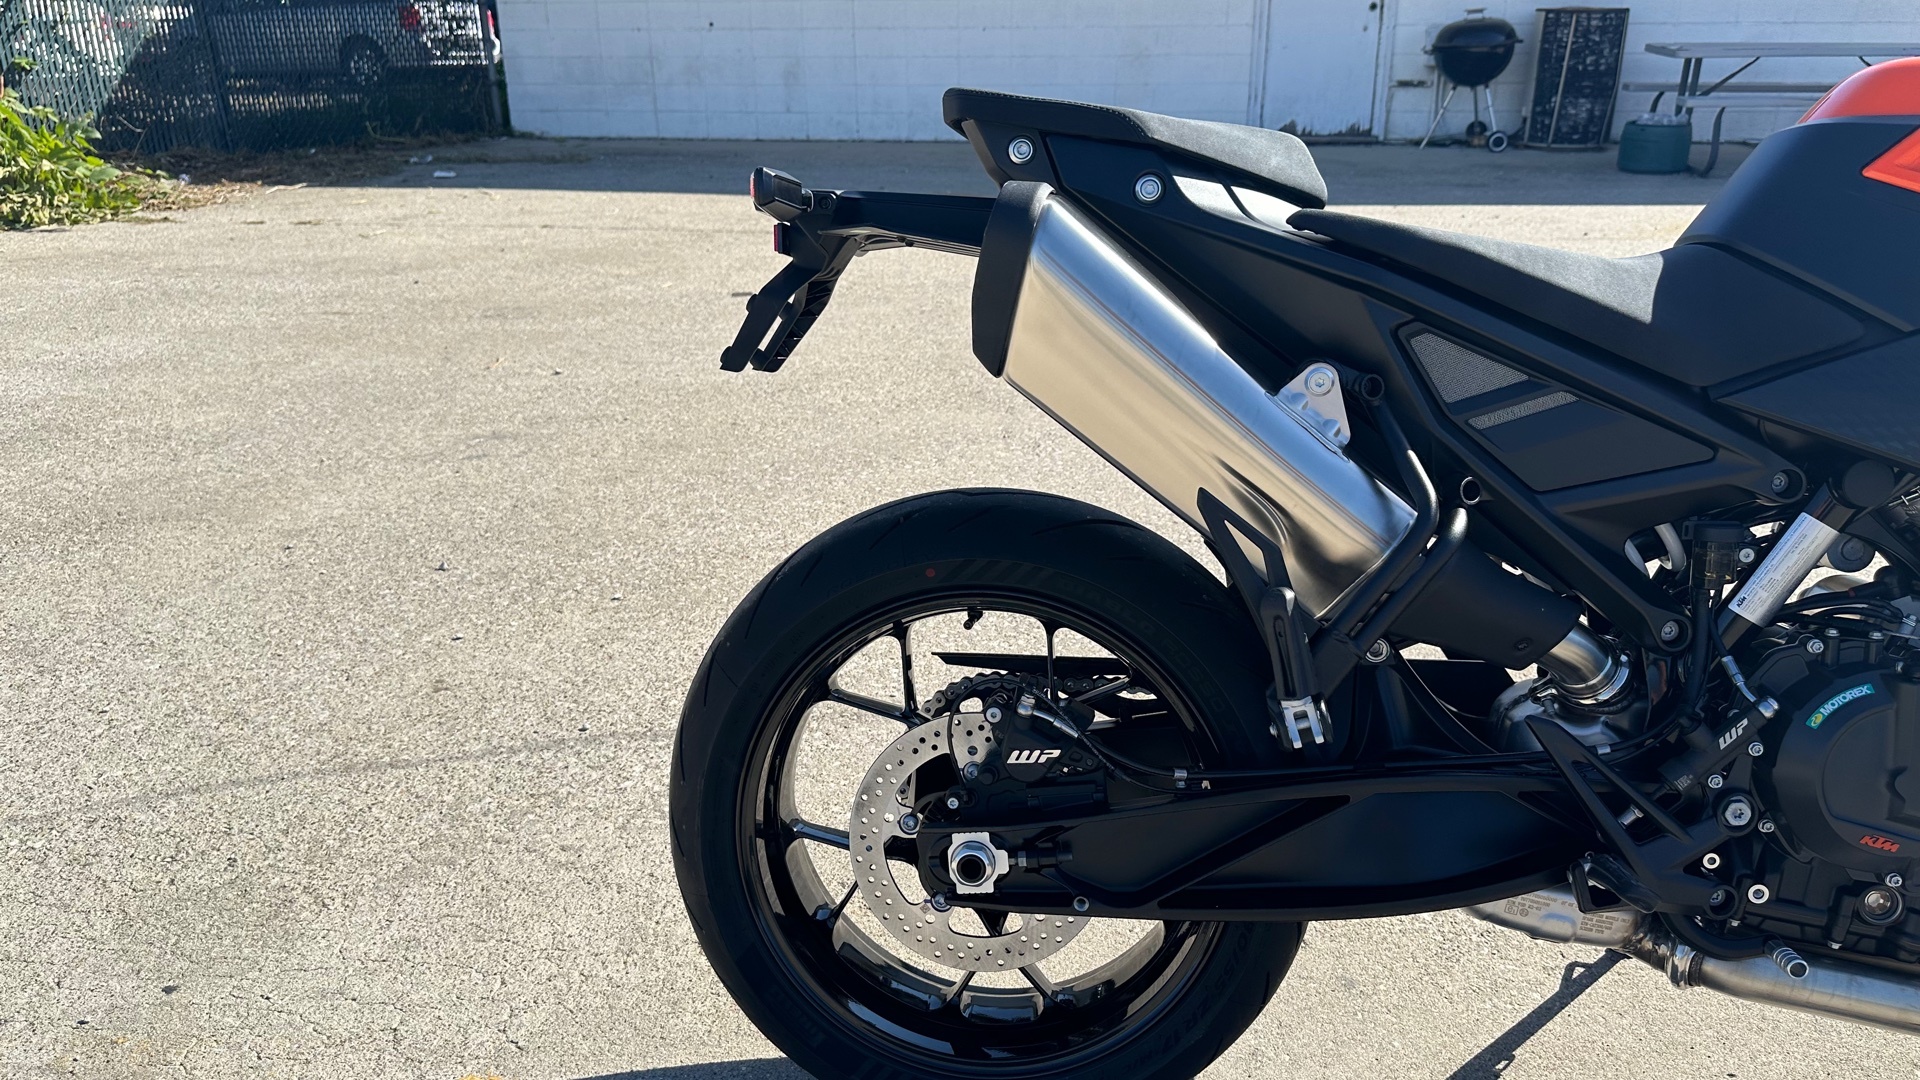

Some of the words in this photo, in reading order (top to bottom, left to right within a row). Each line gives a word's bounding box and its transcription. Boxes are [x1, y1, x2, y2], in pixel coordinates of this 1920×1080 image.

[1737, 596, 1747, 608] KTM
[1820, 685, 1871, 716] MOTOREX
[1718, 718, 1748, 750] WP
[1007, 750, 1061, 764] WP
[1859, 835, 1900, 853] KTM
